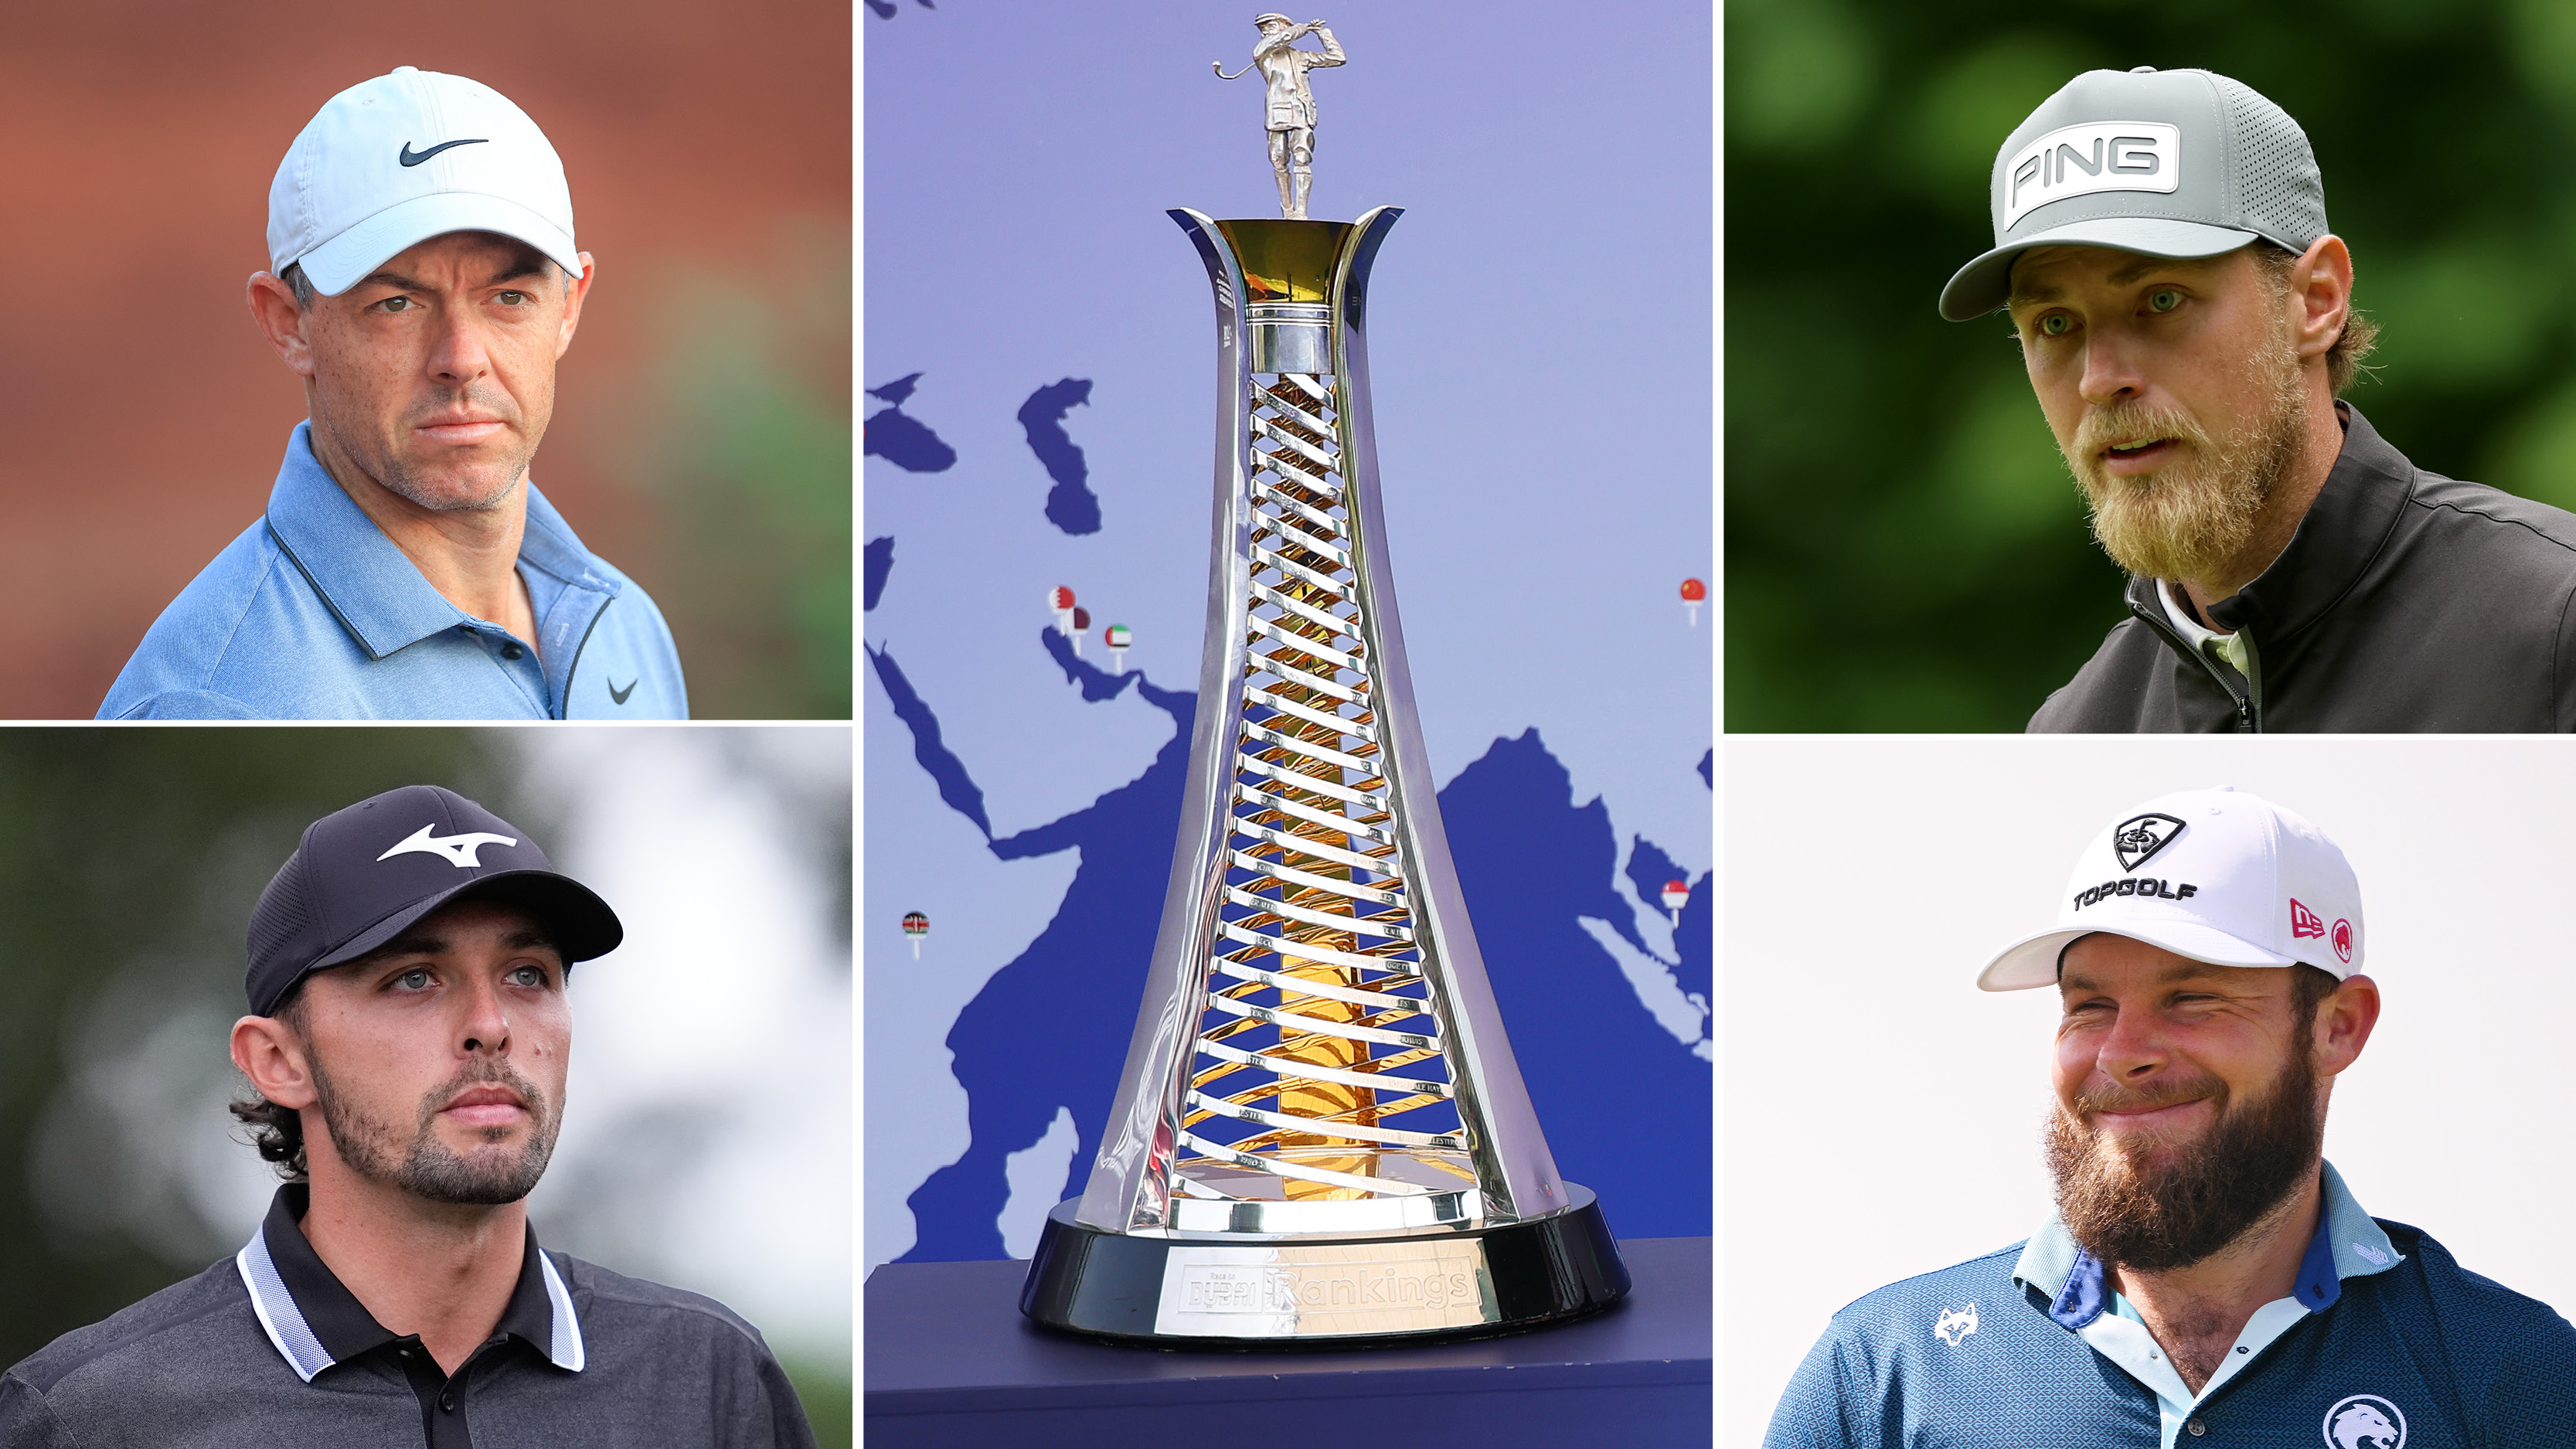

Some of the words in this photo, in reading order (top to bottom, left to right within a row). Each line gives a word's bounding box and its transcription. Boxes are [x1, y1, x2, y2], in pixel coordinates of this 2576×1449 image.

[2013, 136, 2159, 209] PING
[2074, 878, 2197, 912] TOPGOLF
[1274, 1267, 1469, 1309] Rankings
